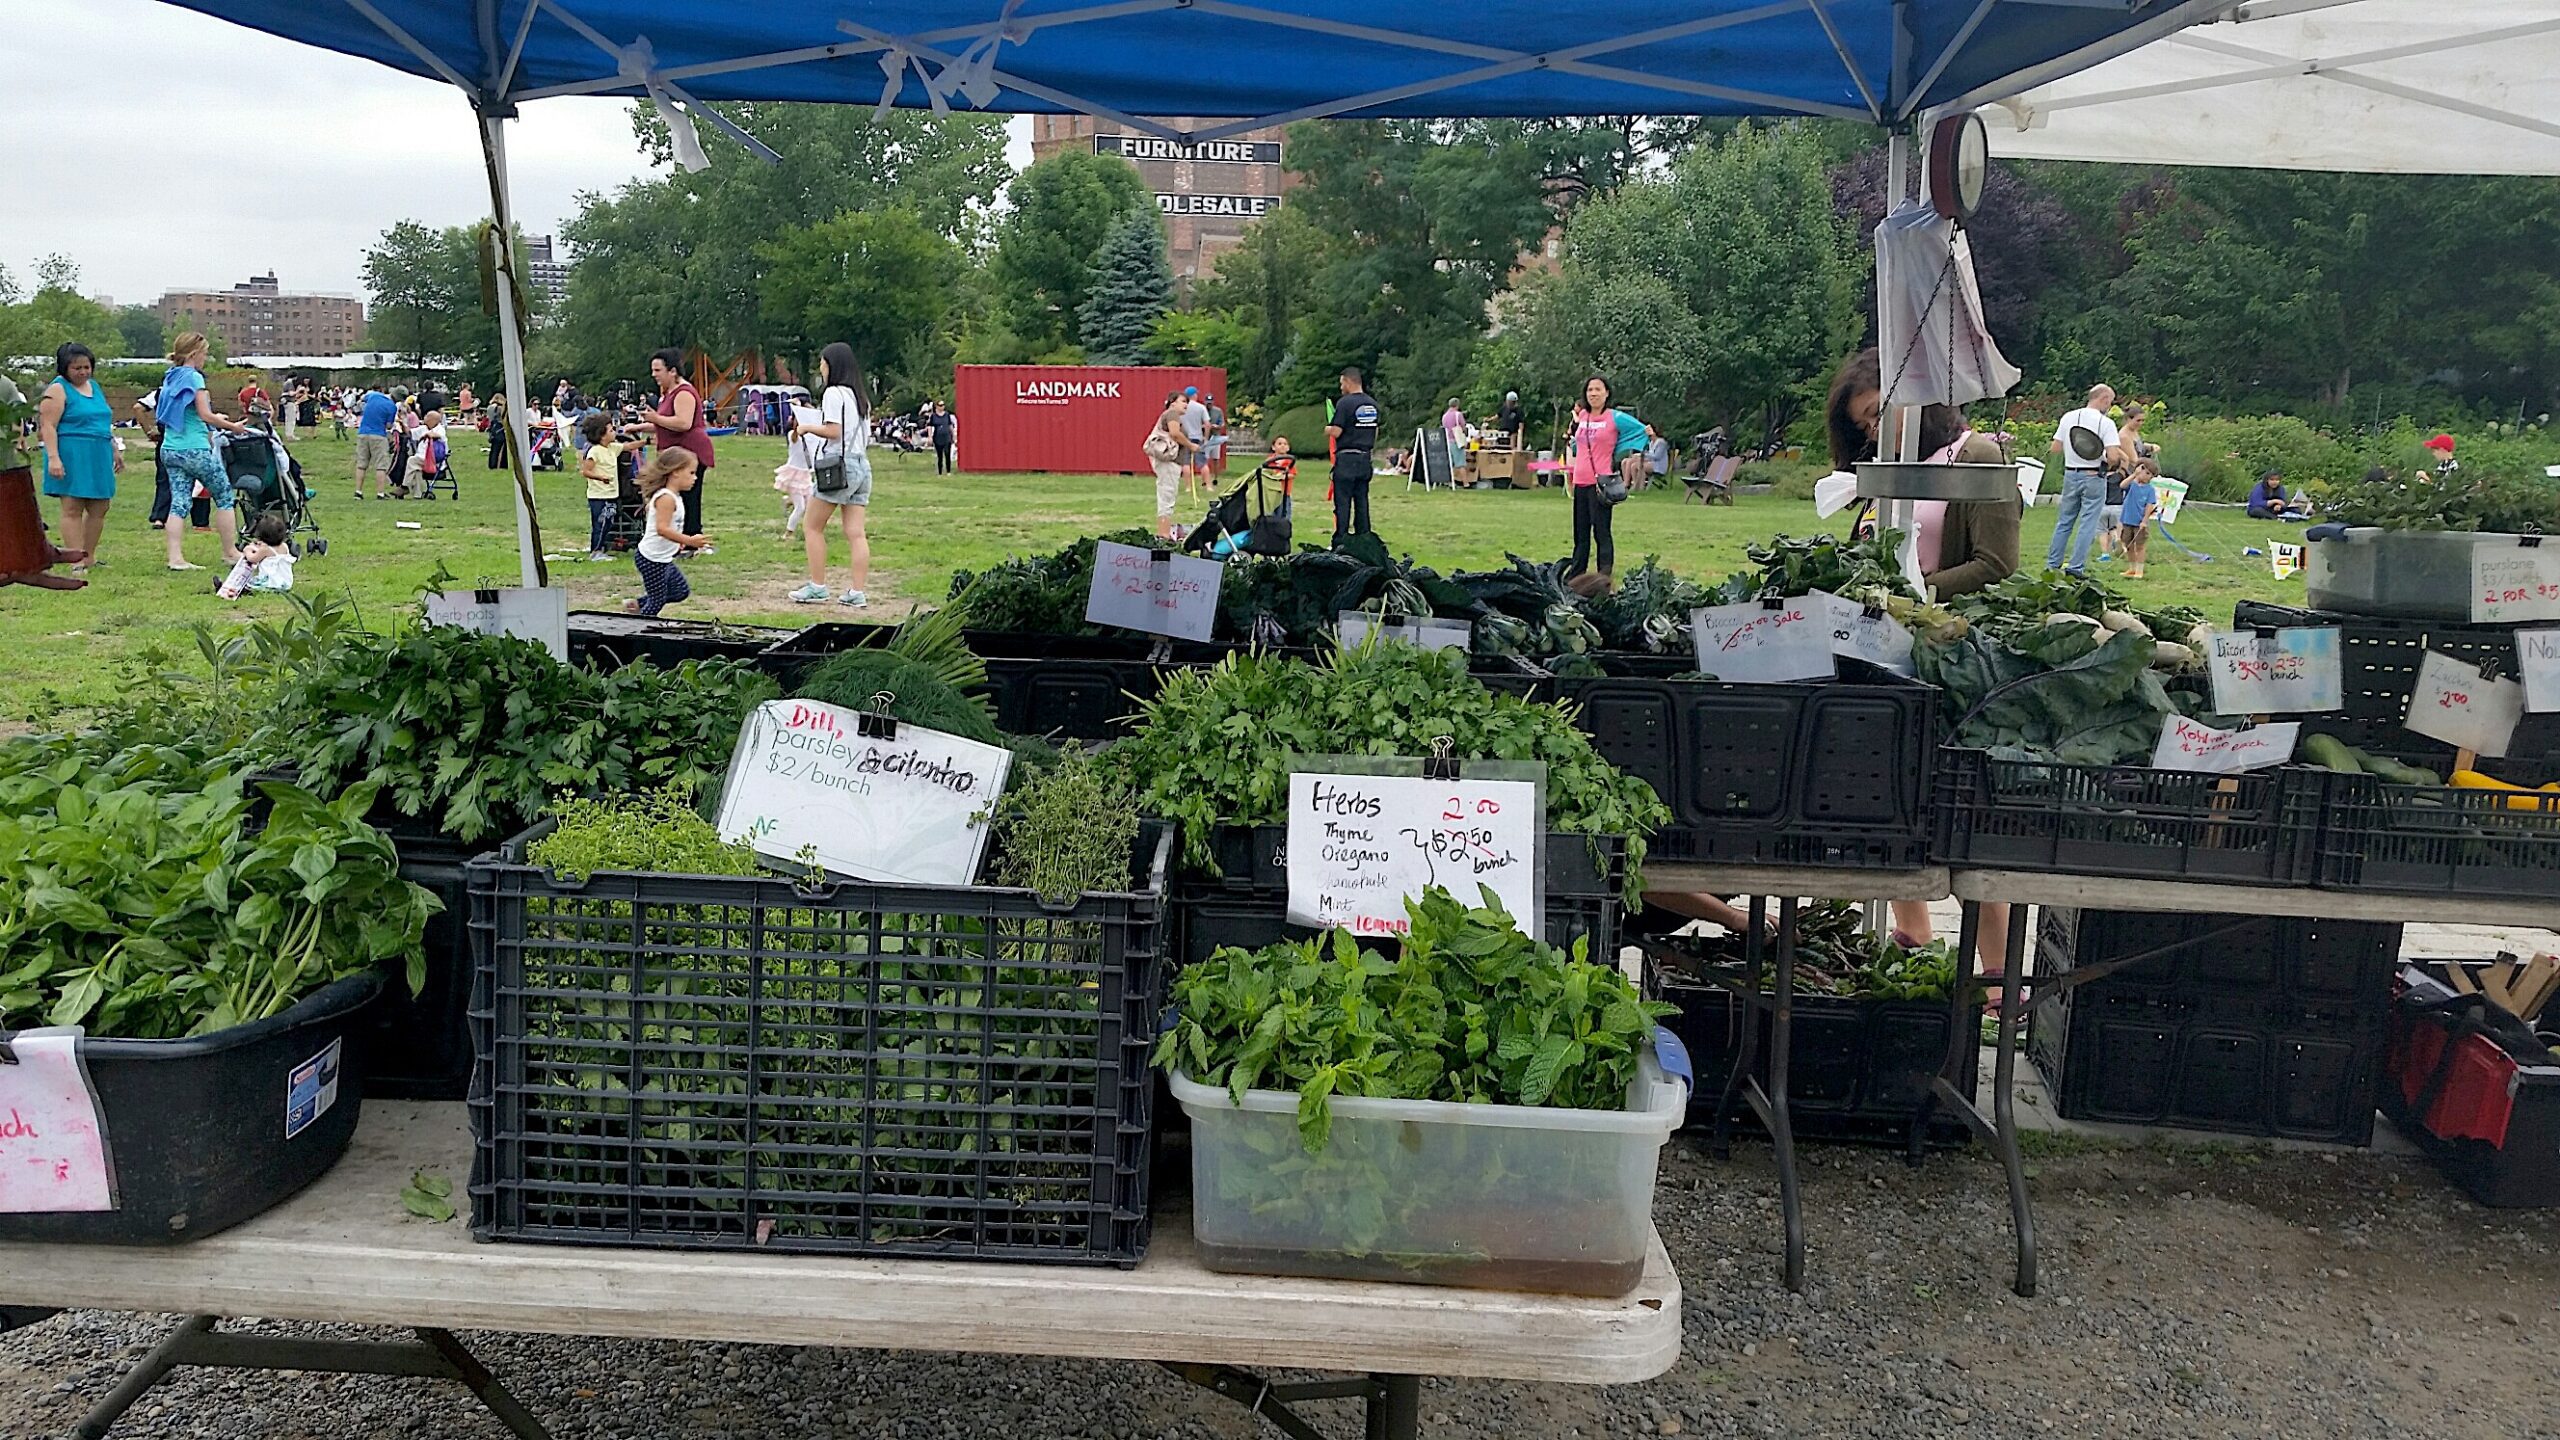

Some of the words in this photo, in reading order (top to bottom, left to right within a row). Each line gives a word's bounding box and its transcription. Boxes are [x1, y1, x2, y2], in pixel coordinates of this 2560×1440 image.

[1121, 139, 1254, 161] FURNITURE
[1016, 380, 1121, 398] LANDMARK
[2481, 557, 2535, 574] purslane
[2484, 589, 2499, 603] 2
[2503, 588, 2532, 603] FOR
[434, 607, 461, 622] herb
[1773, 610, 1805, 629] Sale
[772, 727, 862, 769] parsley
[765, 750, 871, 797] $2/bunch
[1312, 781, 1381, 818] Herbs
[1323, 822, 1374, 845] Thyme
[1321, 844, 1390, 870] Oregano
[1472, 850, 1519, 874] bunch
[1319, 893, 1356, 913] Mint
[1356, 914, 1408, 933] lemon
[0, 1108, 39, 1138] ch
